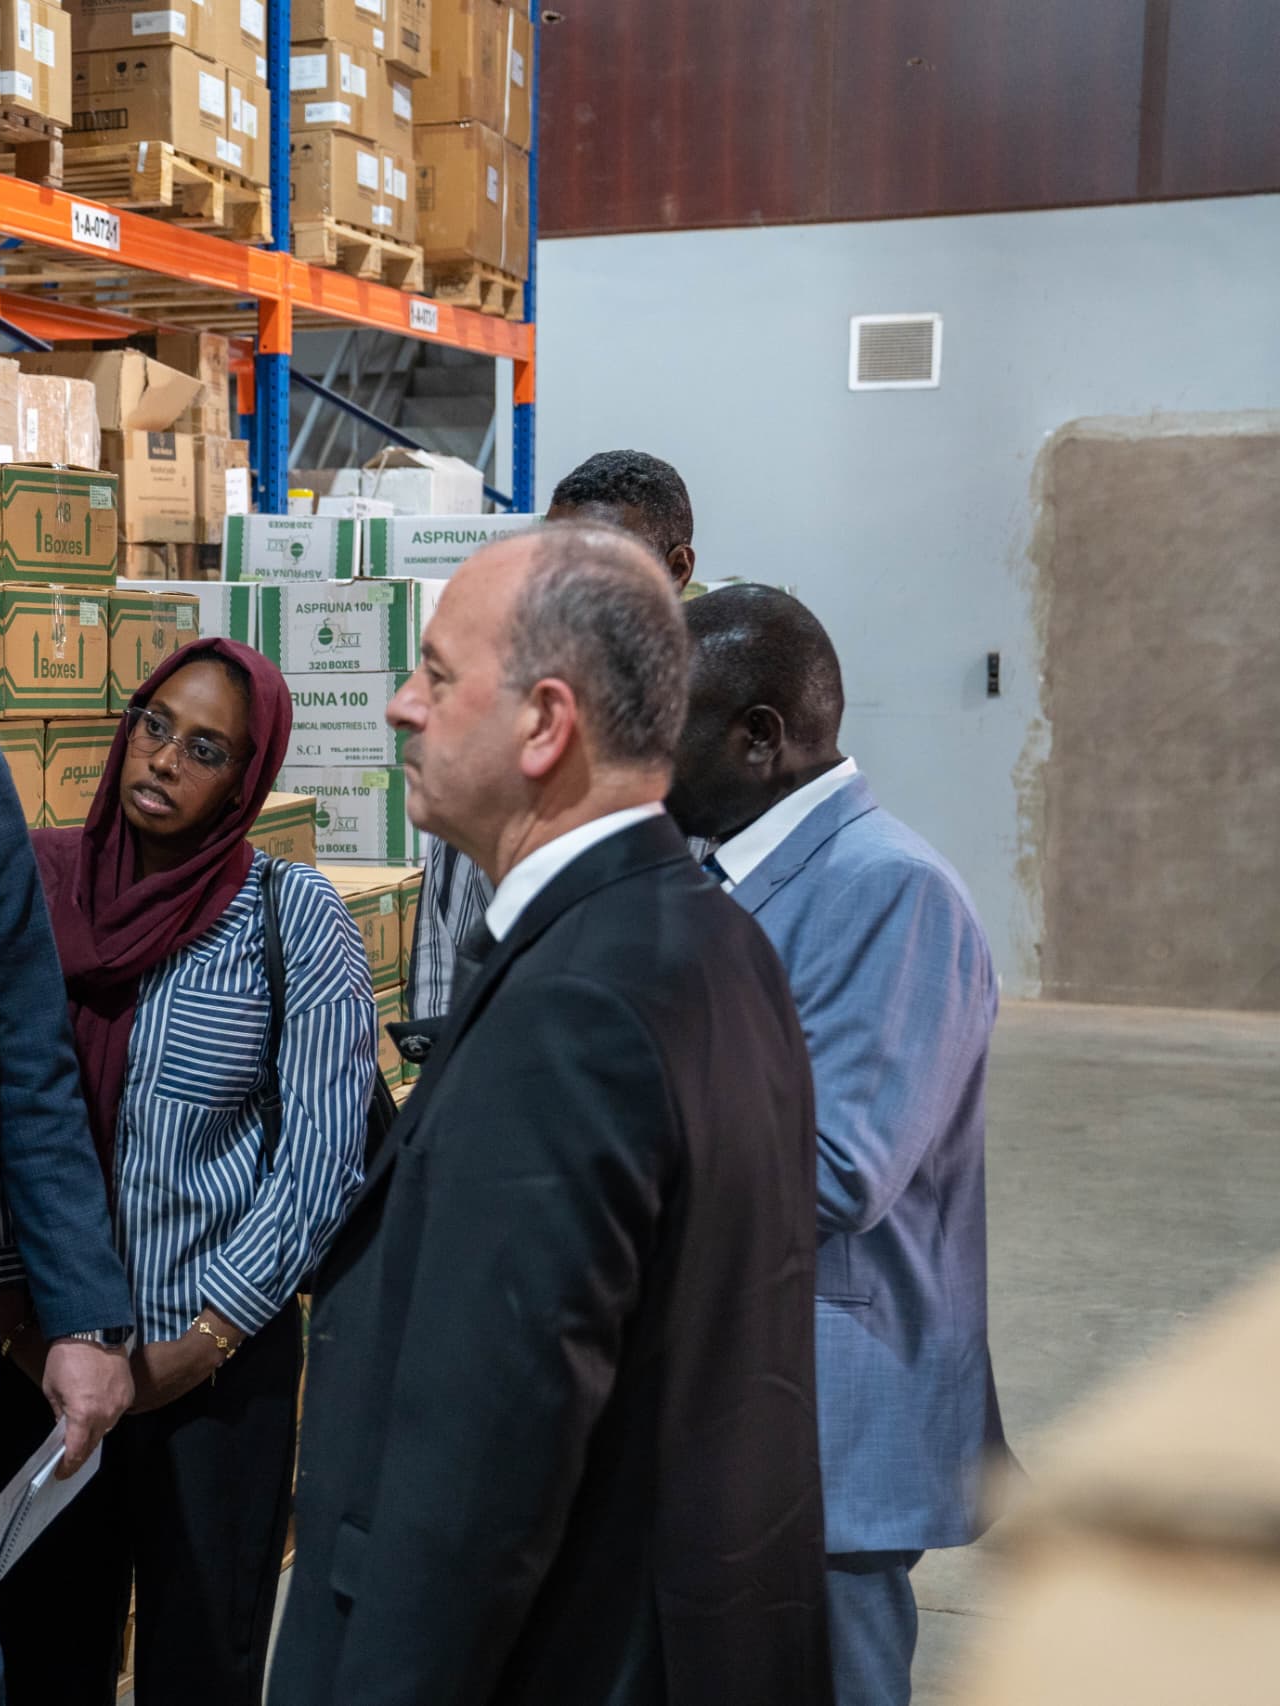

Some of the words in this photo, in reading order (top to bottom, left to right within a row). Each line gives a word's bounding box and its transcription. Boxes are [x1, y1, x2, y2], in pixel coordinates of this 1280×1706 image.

[75, 210, 118, 244] 1-A-072-1
[44, 533, 82, 555] Boxes
[411, 530, 488, 544] ASPRUNA
[295, 602, 352, 614] ASPRUNA
[152, 628, 164, 649] 48
[41, 657, 76, 679] Boxes
[308, 661, 327, 670] 320
[328, 660, 360, 669] BOXES
[291, 692, 338, 707] RUNA
[340, 692, 368, 707] 100
[292, 722, 319, 730] EMICAL
[320, 722, 362, 730] INDUSTRIES
[293, 786, 350, 797] ASPRUNA
[351, 786, 370, 796] 100
[326, 844, 358, 853] BOXES
